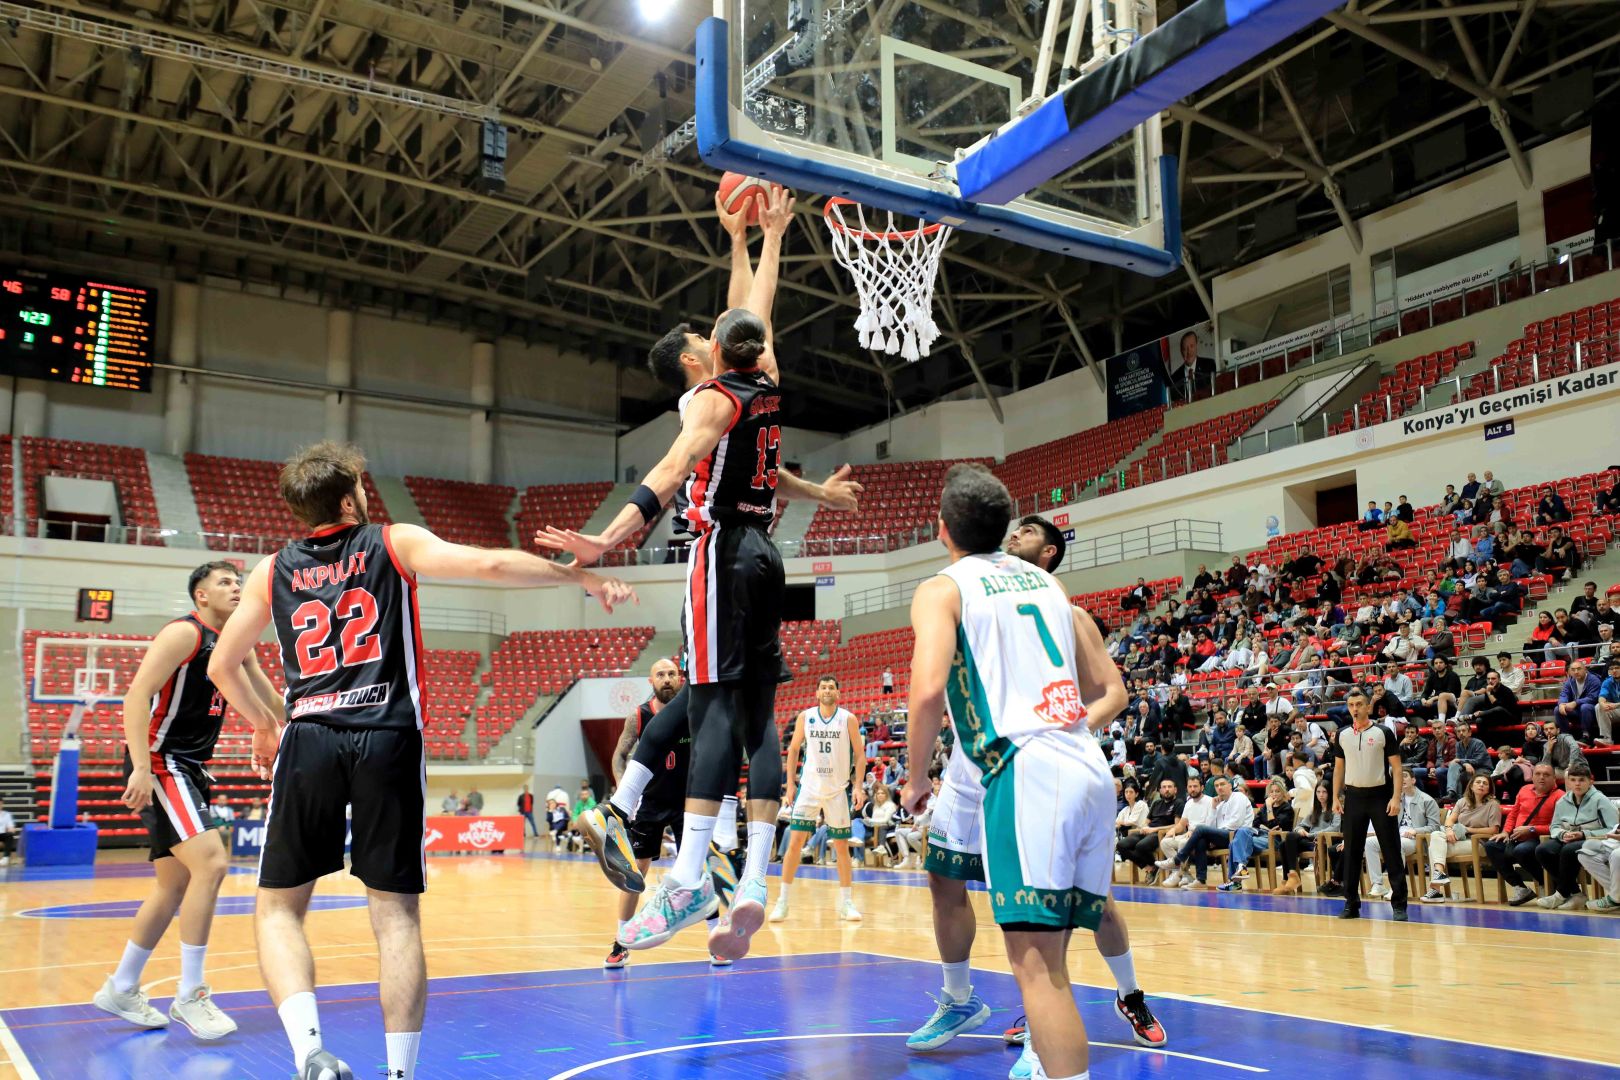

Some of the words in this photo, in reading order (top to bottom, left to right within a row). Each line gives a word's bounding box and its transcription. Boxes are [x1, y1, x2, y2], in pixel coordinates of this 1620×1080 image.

[1479, 384, 1553, 416] Geçmişi
[1557, 369, 1619, 397] Kadar
[1486, 426, 1503, 437] ALT
[291, 551, 367, 593] AKPULAT
[291, 586, 383, 679] 22
[1016, 603, 1064, 668] 7
[340, 684, 387, 705] TOUCH
[810, 730, 841, 739] KARATAY
[819, 741, 832, 754] 16
[665, 750, 676, 770] 0
[457, 828, 506, 844] KARATAY
[469, 820, 496, 832] KAFE
